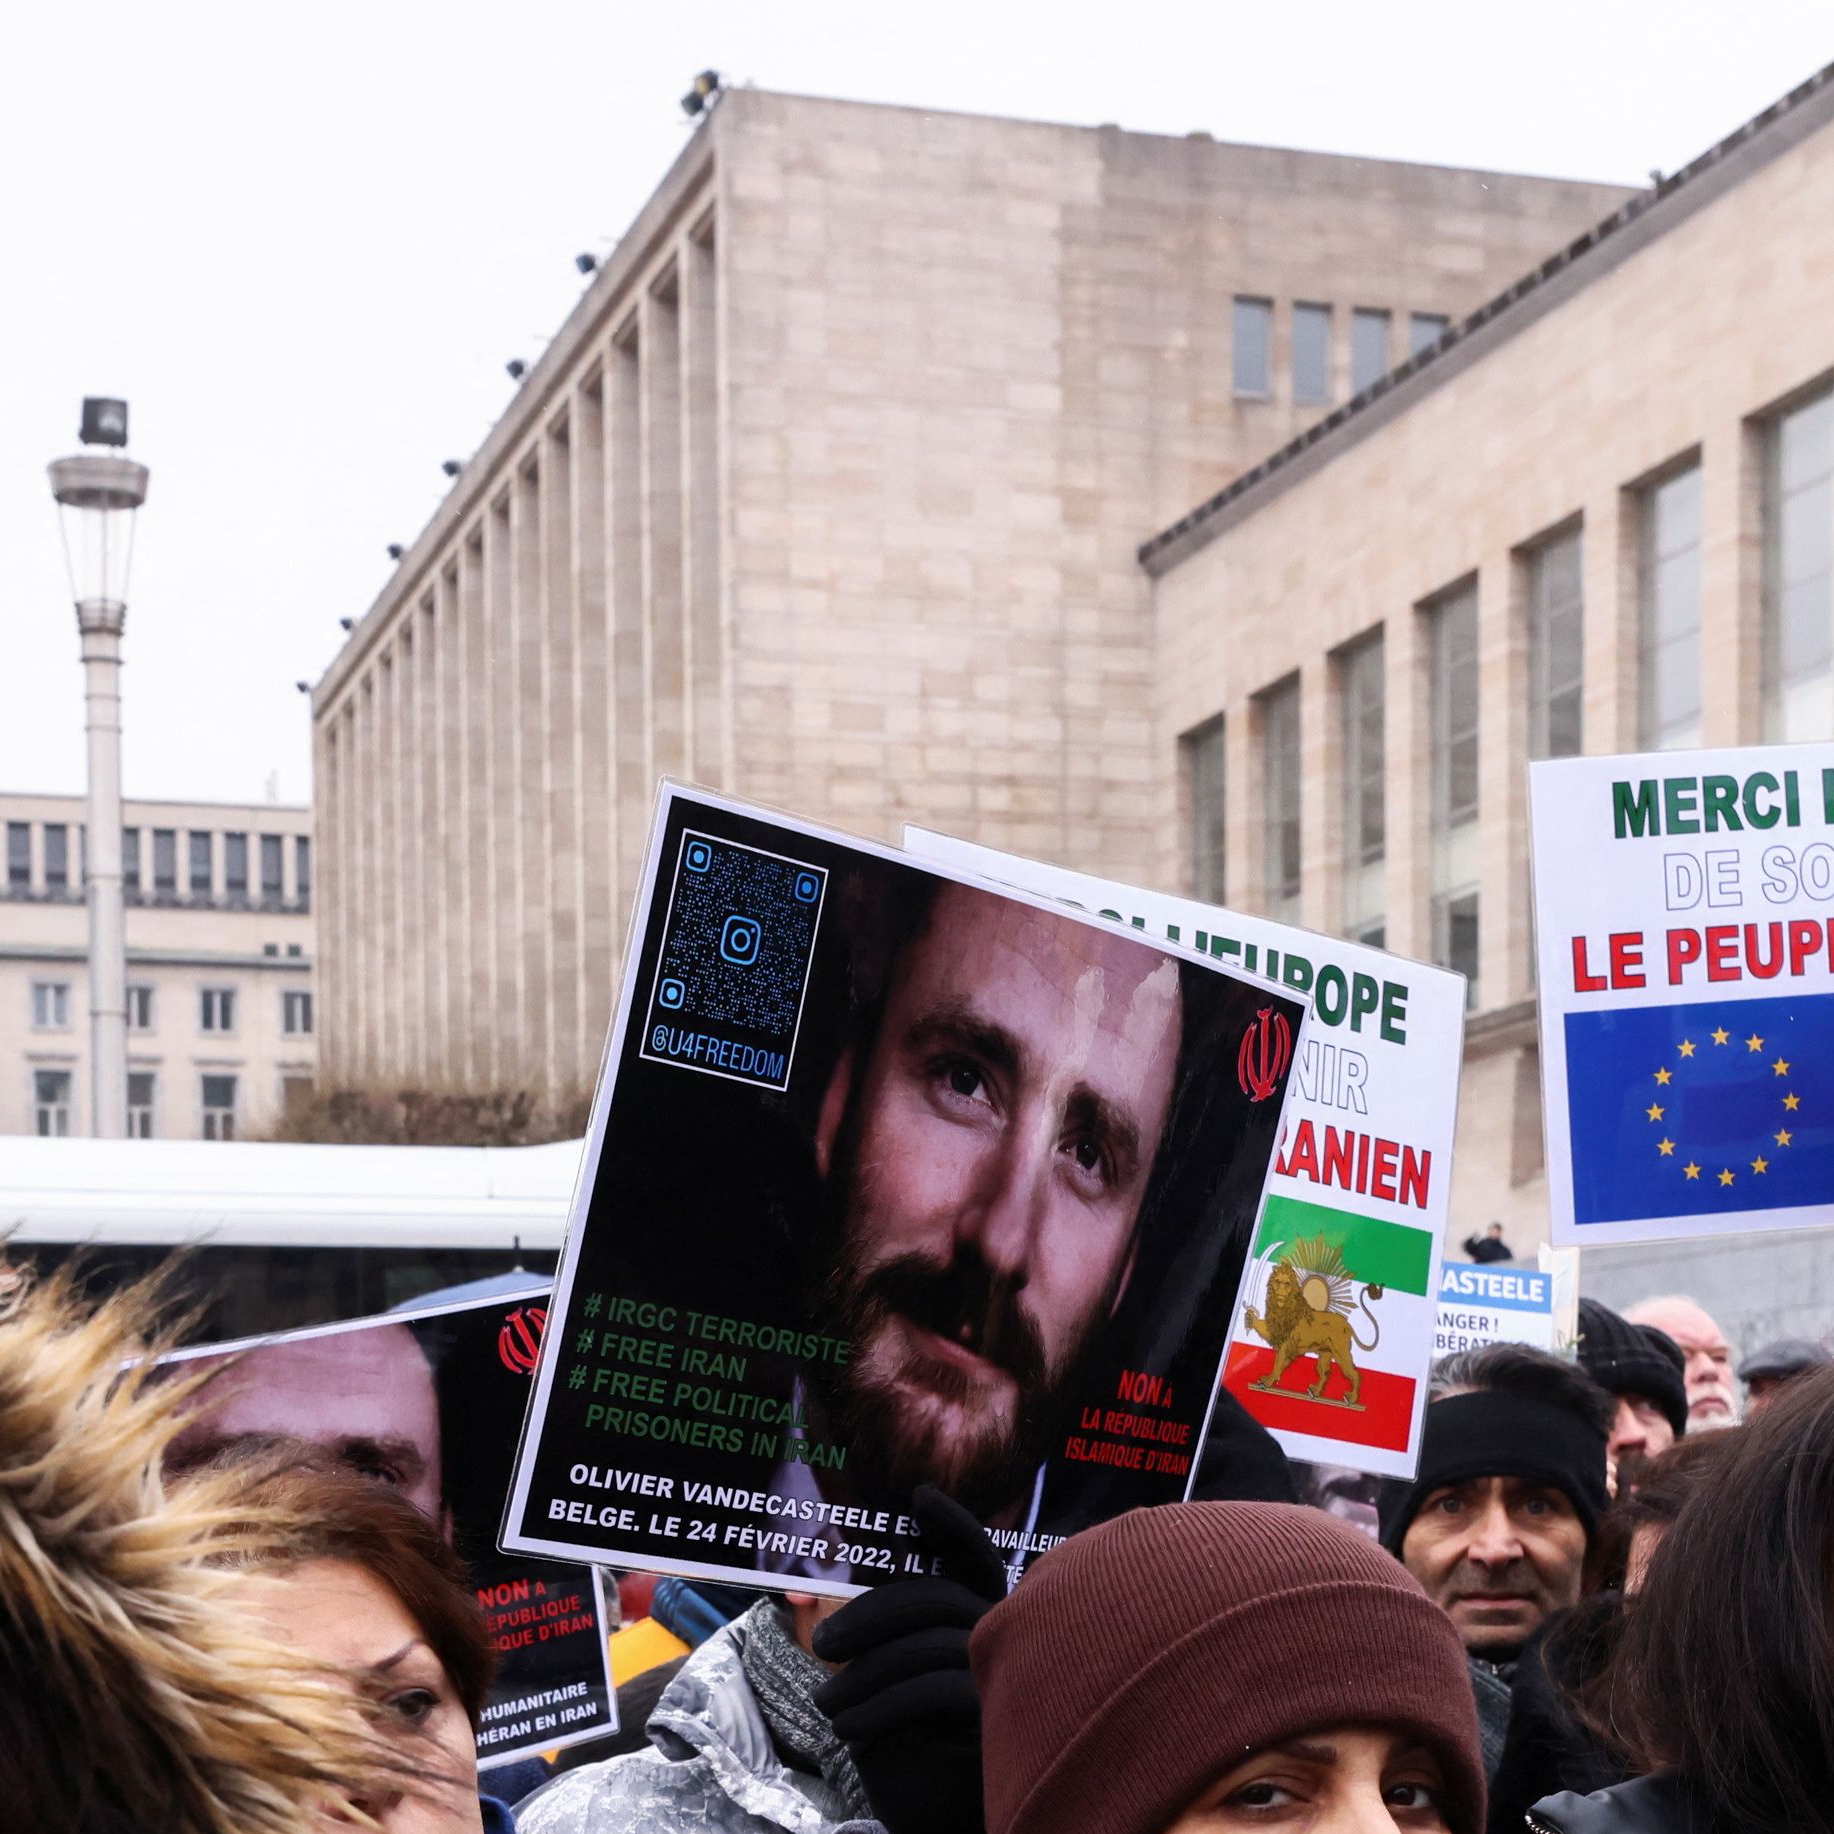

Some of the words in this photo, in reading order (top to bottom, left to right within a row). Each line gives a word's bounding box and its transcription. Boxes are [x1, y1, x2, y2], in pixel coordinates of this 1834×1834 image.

[1612, 770, 1801, 839] MERCI
[1663, 849, 1743, 911] DE
[1571, 931, 1647, 993] LE
[650, 1023, 786, 1081] @U4FREEDOM
[1442, 1270, 1544, 1302] ASTEELE
[608, 1296, 678, 1332] IRGC
[600, 1332, 675, 1369] FREE
[680, 1348, 747, 1382] IRAN
[592, 1368, 668, 1404] FREE
[1117, 1369, 1161, 1405] NON
[584, 1404, 745, 1452] PRISONERS
[569, 1463, 674, 1499] OLIVIER
[682, 1481, 889, 1533] VANDECASTEELE
[548, 1498, 640, 1532] BELGE.
[648, 1513, 681, 1538] LE
[686, 1520, 717, 1544] 24
[723, 1524, 829, 1559] FÉVRIER
[834, 1542, 896, 1574] 2022,
[539, 1613, 594, 1640] D'IRAN
[477, 1720, 532, 1746] HÉRAN
